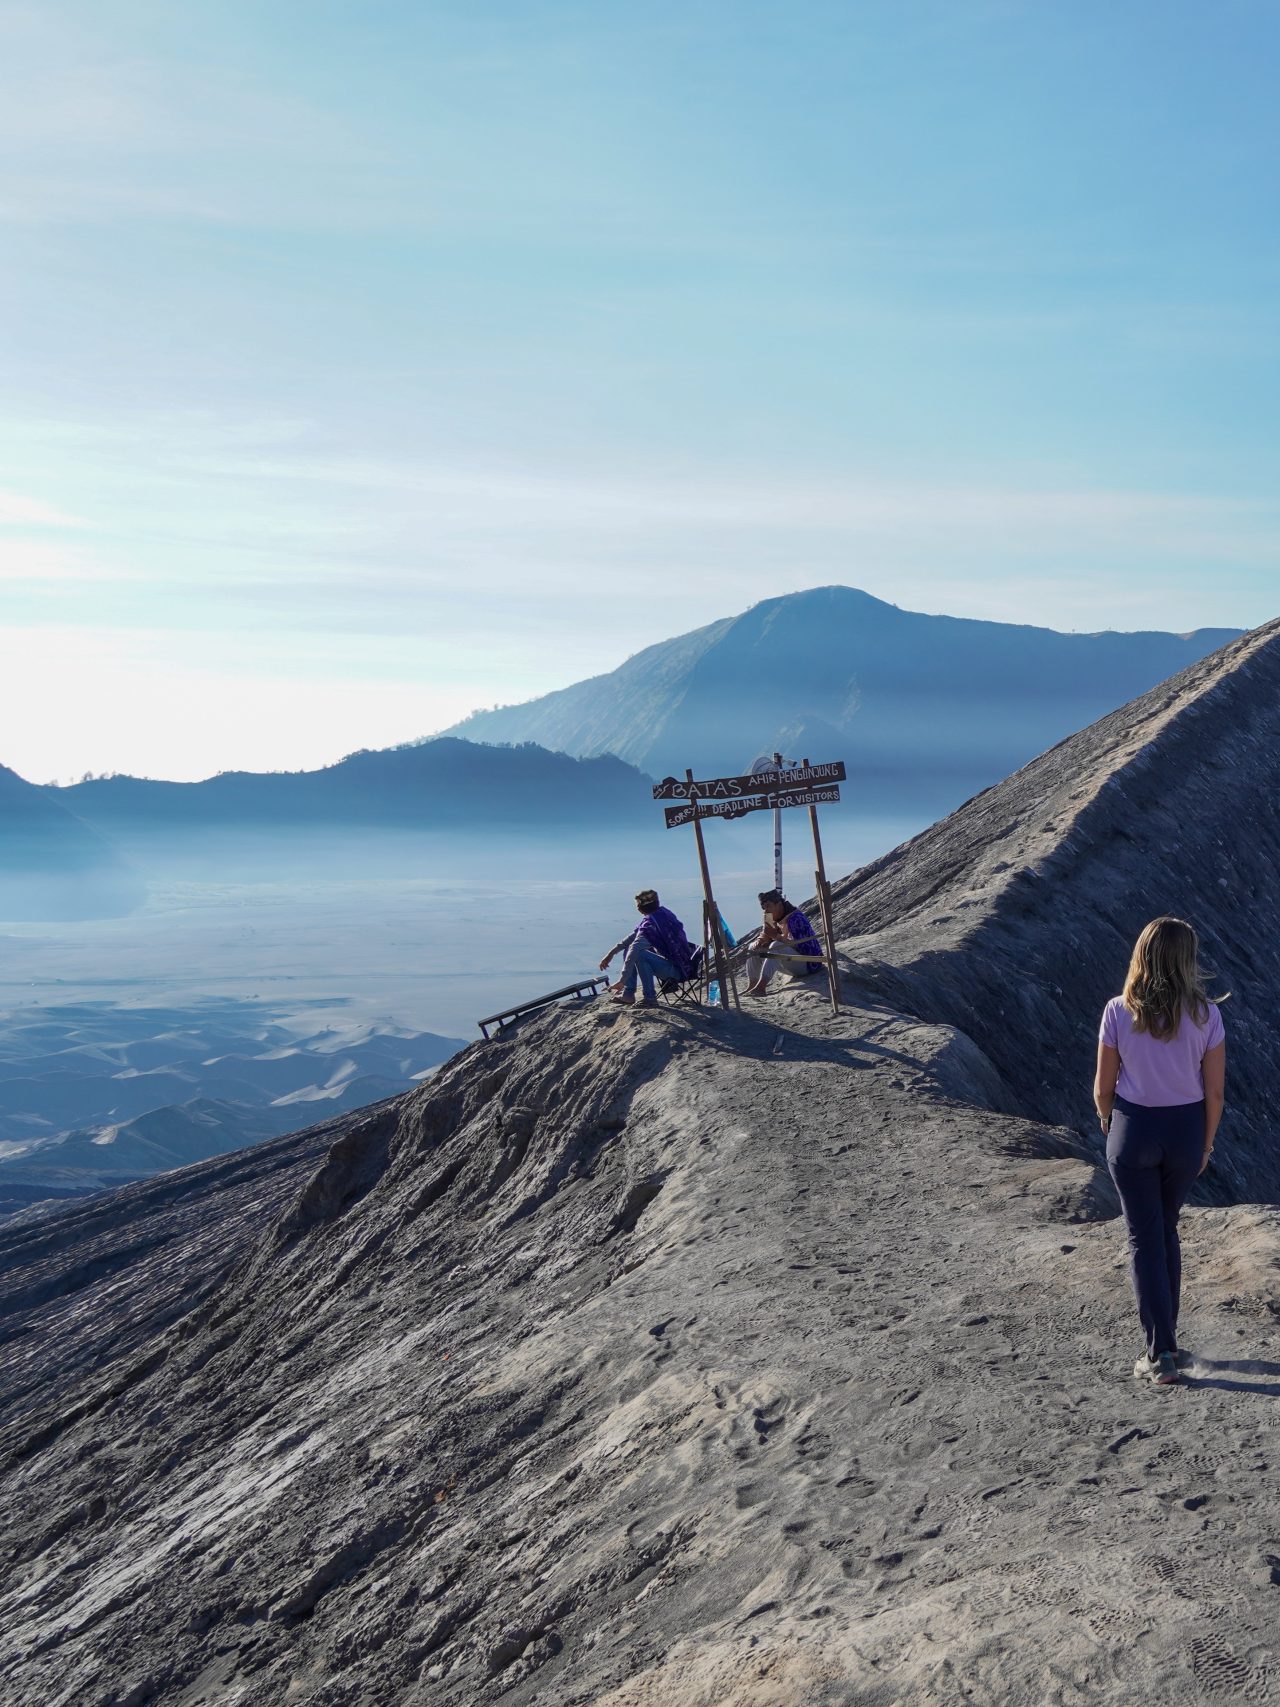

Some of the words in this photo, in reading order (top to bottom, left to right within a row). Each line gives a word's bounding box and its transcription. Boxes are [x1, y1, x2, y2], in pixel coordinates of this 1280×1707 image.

[672, 780, 742, 798] BATAS
[748, 773, 777, 787] AHIR
[778, 763, 839, 784] PENGUNJUNG
[712, 799, 762, 814] DEADLINE
[767, 792, 795, 808] FOR
[795, 791, 840, 804] VISITORS
